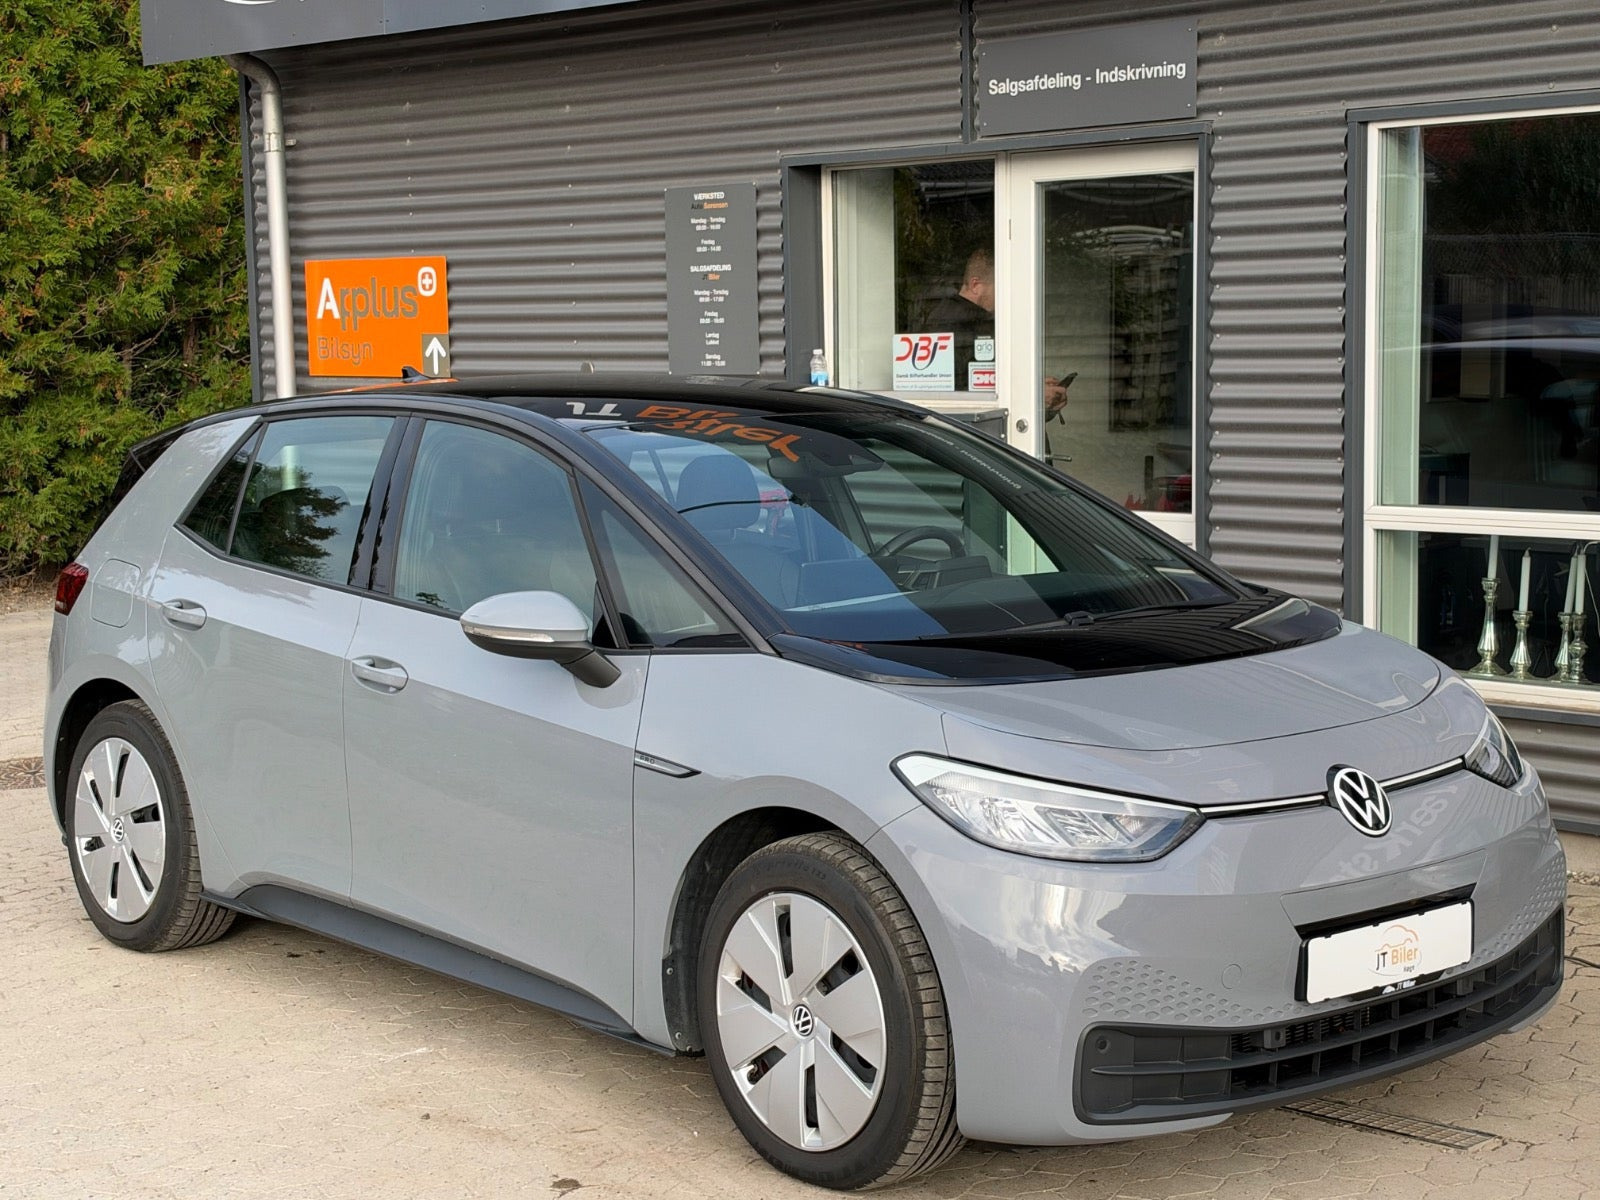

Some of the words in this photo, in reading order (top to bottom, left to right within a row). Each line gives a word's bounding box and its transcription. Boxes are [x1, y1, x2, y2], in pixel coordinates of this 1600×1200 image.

[988, 72, 1081, 97] Salgsafdeling
[1095, 61, 1187, 85] Indskrivning
[690, 264, 732, 272] SALGSAFDELING
[317, 337, 373, 366] Bilsyn
[1376, 951, 1388, 971] JT
[1391, 946, 1418, 966] Biler
